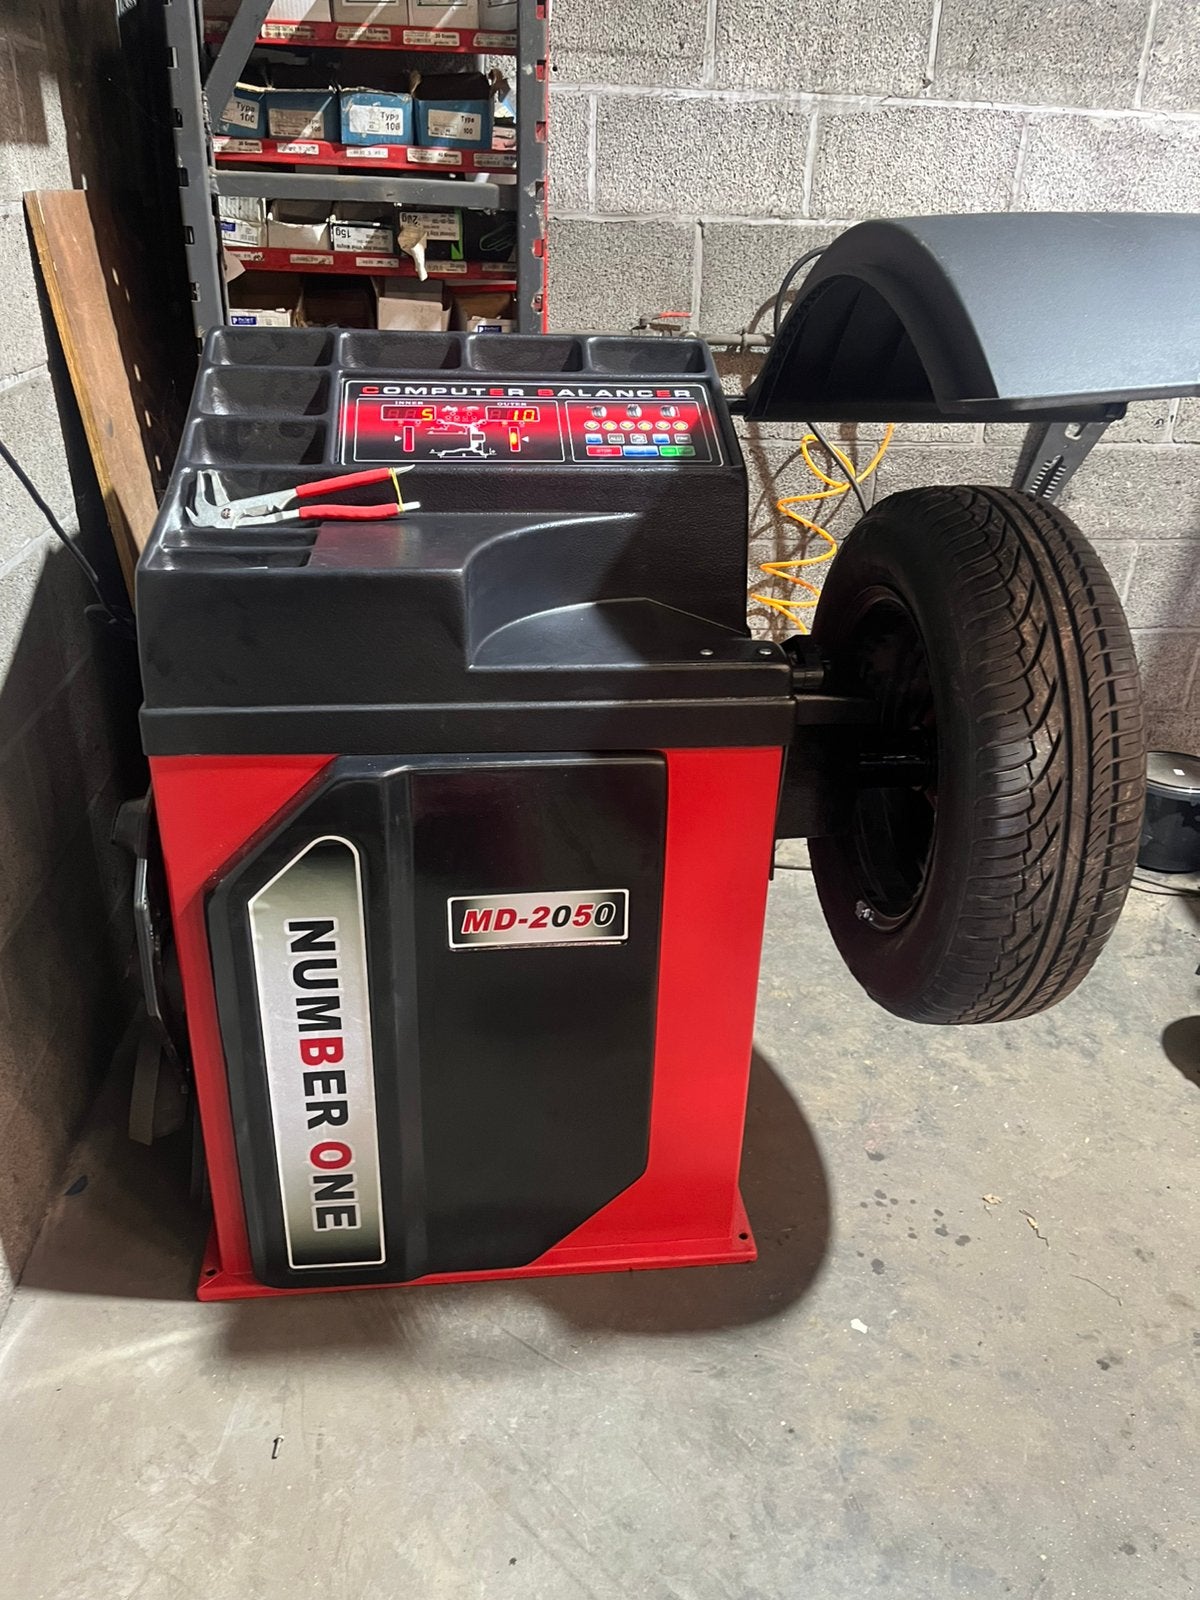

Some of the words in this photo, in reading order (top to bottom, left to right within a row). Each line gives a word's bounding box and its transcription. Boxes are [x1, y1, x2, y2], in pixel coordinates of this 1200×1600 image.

[335, 227, 351, 239] 15g
[362, 386, 525, 397] COMPUTER
[537, 388, 692, 398] BALANCER
[513, 409, 535, 421] 10
[462, 902, 615, 934] MD-2050
[288, 920, 349, 1129] NUMBER
[309, 1141, 357, 1230] ONE
